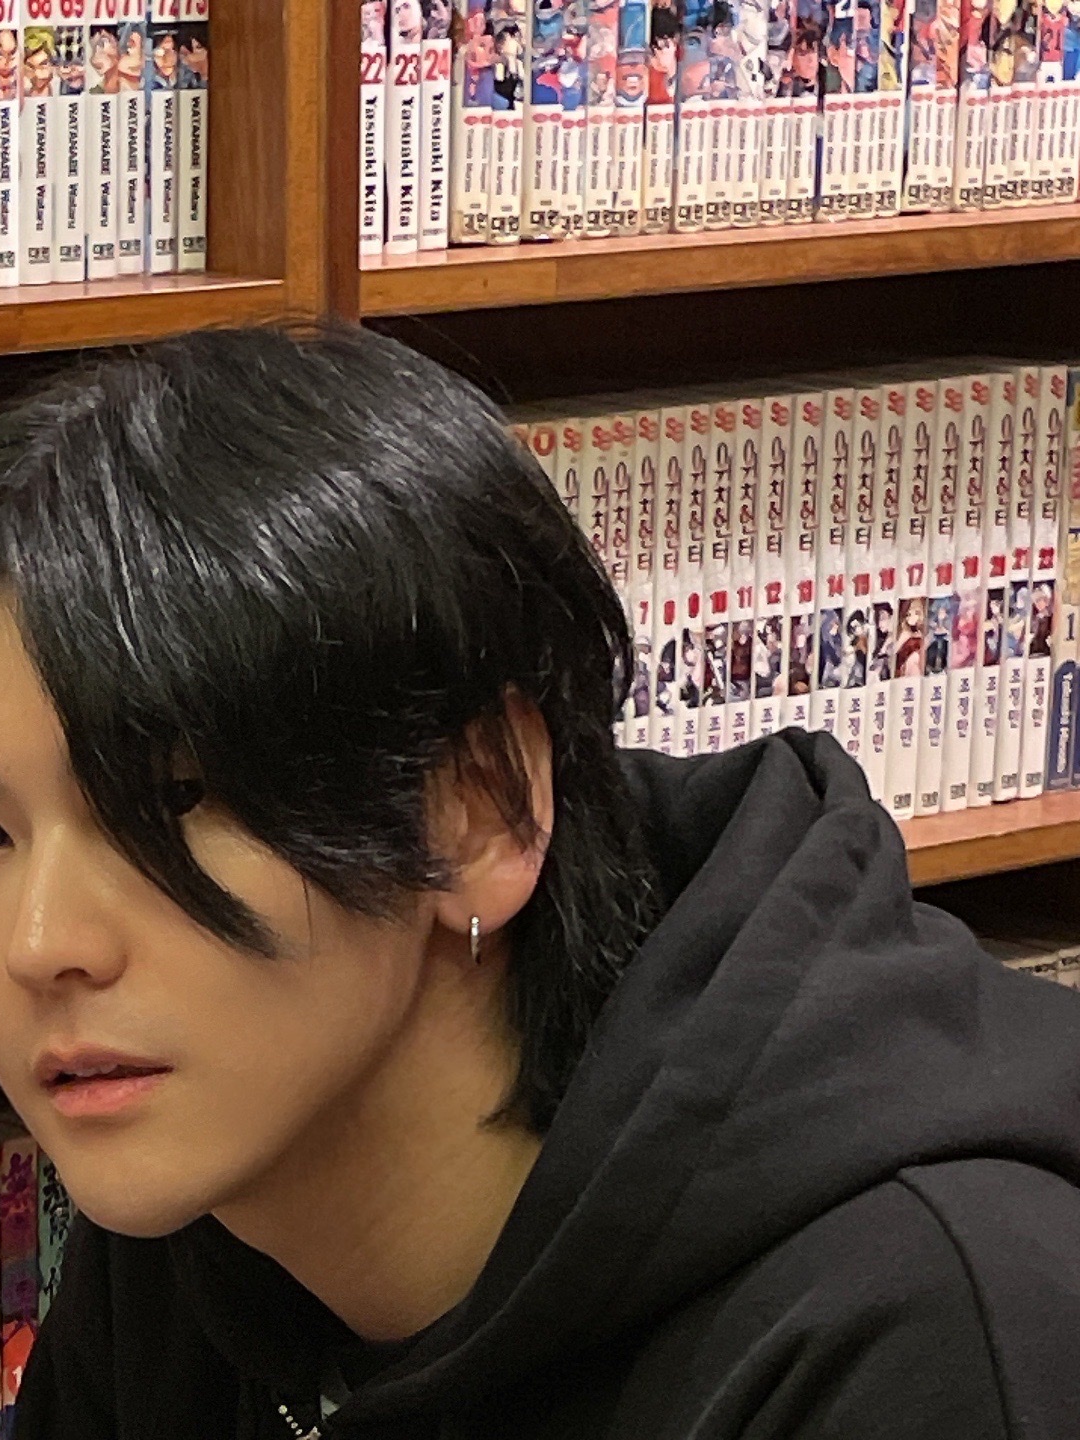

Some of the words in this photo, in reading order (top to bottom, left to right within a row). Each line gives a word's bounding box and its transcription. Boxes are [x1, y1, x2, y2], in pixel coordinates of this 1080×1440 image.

[360, 53, 383, 84] 22
[395, 54, 419, 86] 23
[424, 49, 451, 81] 24
[364, 184, 377, 227] Kita
[399, 184, 413, 227] Kita
[430, 180, 443, 222] Kita
[907, 563, 924, 586] 17
[737, 585, 753, 609] 11
[639, 601, 649, 625] 7
[1065, 612, 1075, 642] 1
